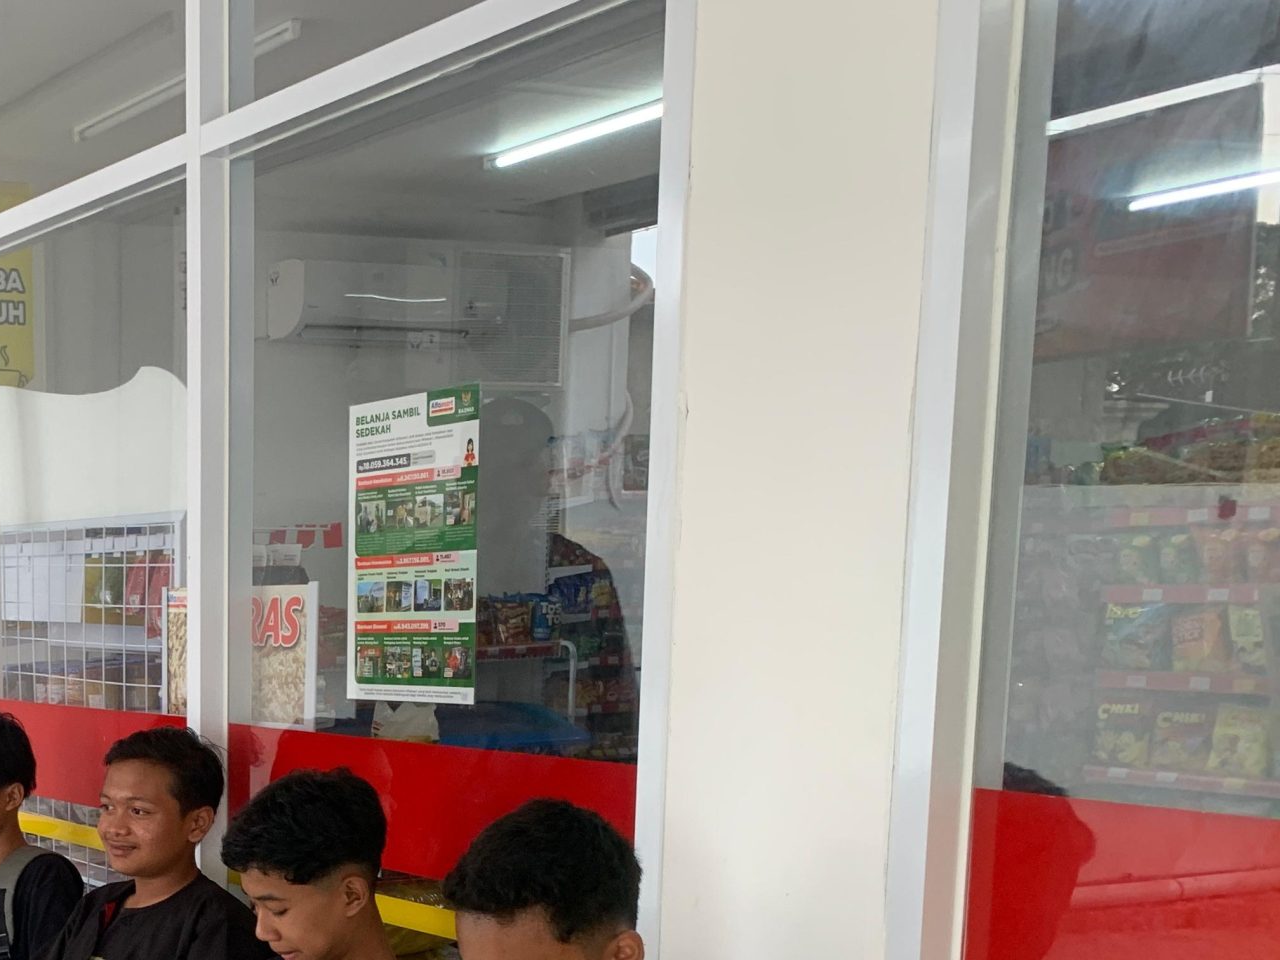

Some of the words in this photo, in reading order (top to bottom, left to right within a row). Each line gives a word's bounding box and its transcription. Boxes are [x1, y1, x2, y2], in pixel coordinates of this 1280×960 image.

[355, 410, 391, 427] BELANJA
[391, 406, 421, 421] SAMBIL
[355, 424, 391, 438] SEDEKAH
